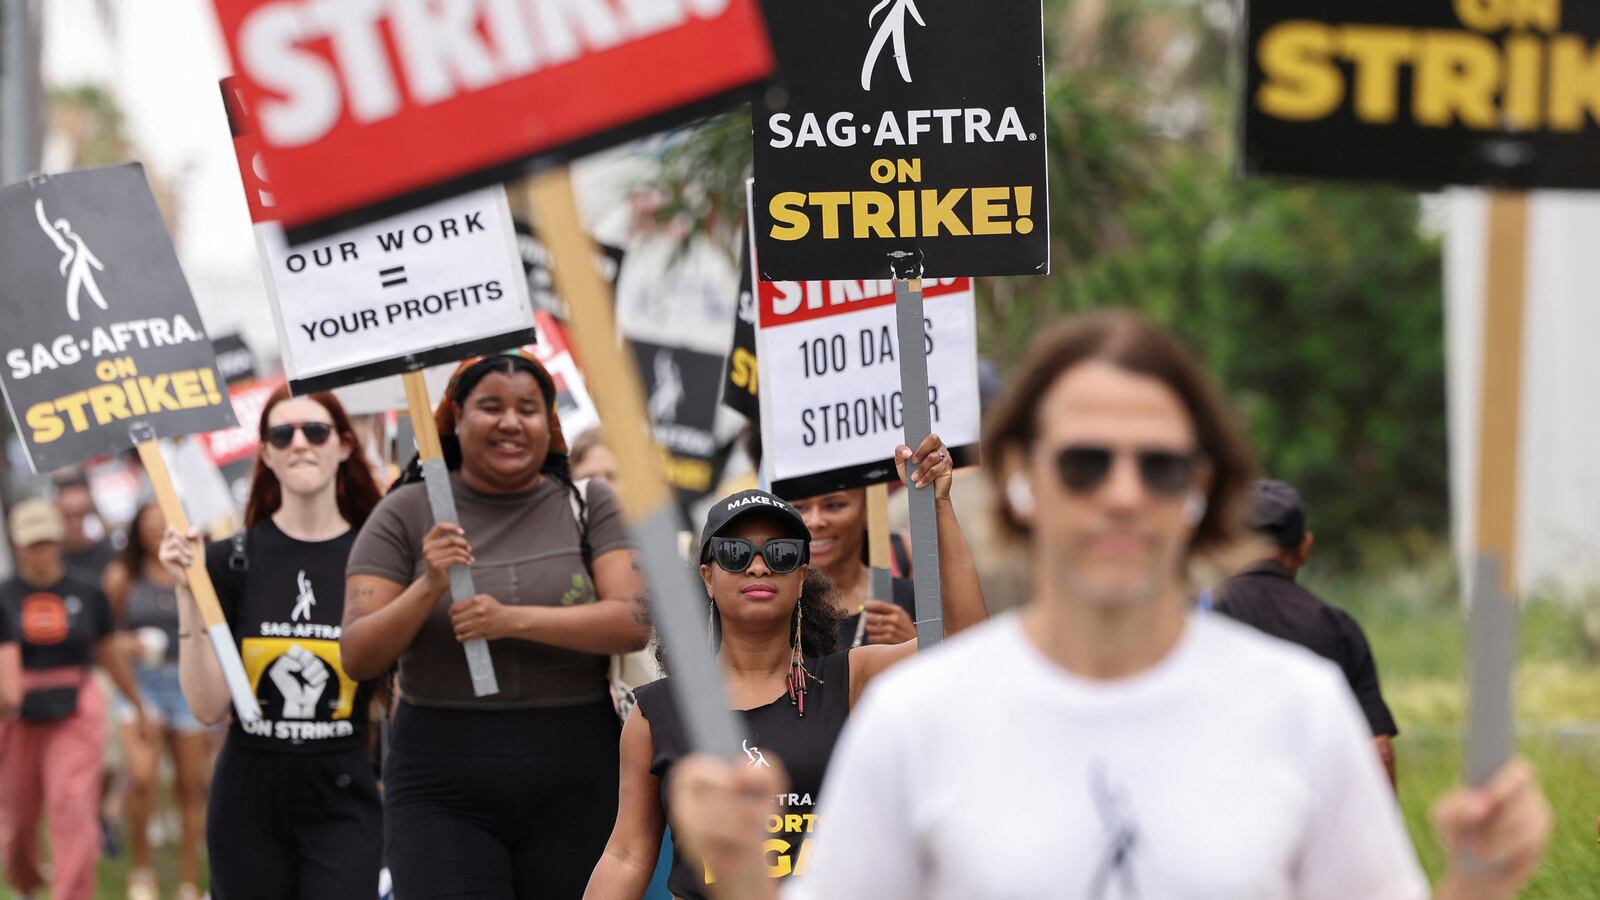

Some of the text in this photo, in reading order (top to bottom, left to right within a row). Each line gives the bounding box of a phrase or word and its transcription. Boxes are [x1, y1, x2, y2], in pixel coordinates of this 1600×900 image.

[238, 0, 729, 148] STRI
[870, 158, 922, 184] ON
[286, 211, 486, 273] OUR WORK
[769, 186, 1034, 241] STRIKE!
[301, 280, 503, 342] YOUR PROFITS
[95, 355, 138, 382] ON
[798, 334, 847, 378] 100
[859, 317, 933, 368] DAS
[25, 367, 222, 444] STRIKE!
[801, 386, 940, 447] STRONGR
[727, 496, 771, 511] MAKE
